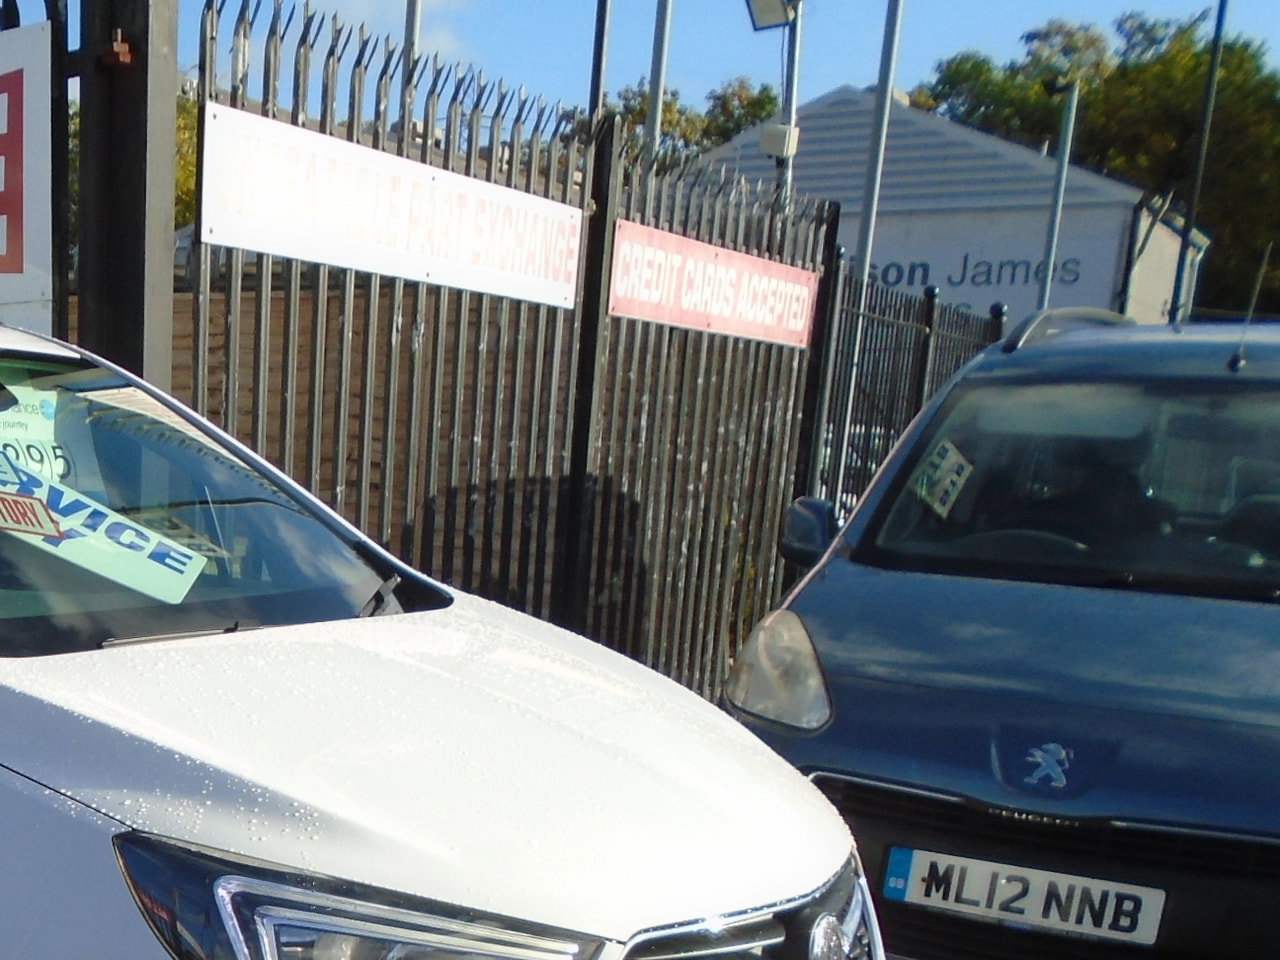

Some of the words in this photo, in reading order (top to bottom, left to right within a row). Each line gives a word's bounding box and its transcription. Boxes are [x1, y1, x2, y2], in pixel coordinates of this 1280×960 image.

[471, 197, 580, 285] EXCHANGE
[947, 253, 1082, 287] James
[615, 241, 683, 305] CREDIT
[682, 258, 737, 316] CARDS
[736, 272, 810, 331] ACCEPTED
[923, 860, 1031, 915] ML12
[1041, 880, 1143, 934] NNB
